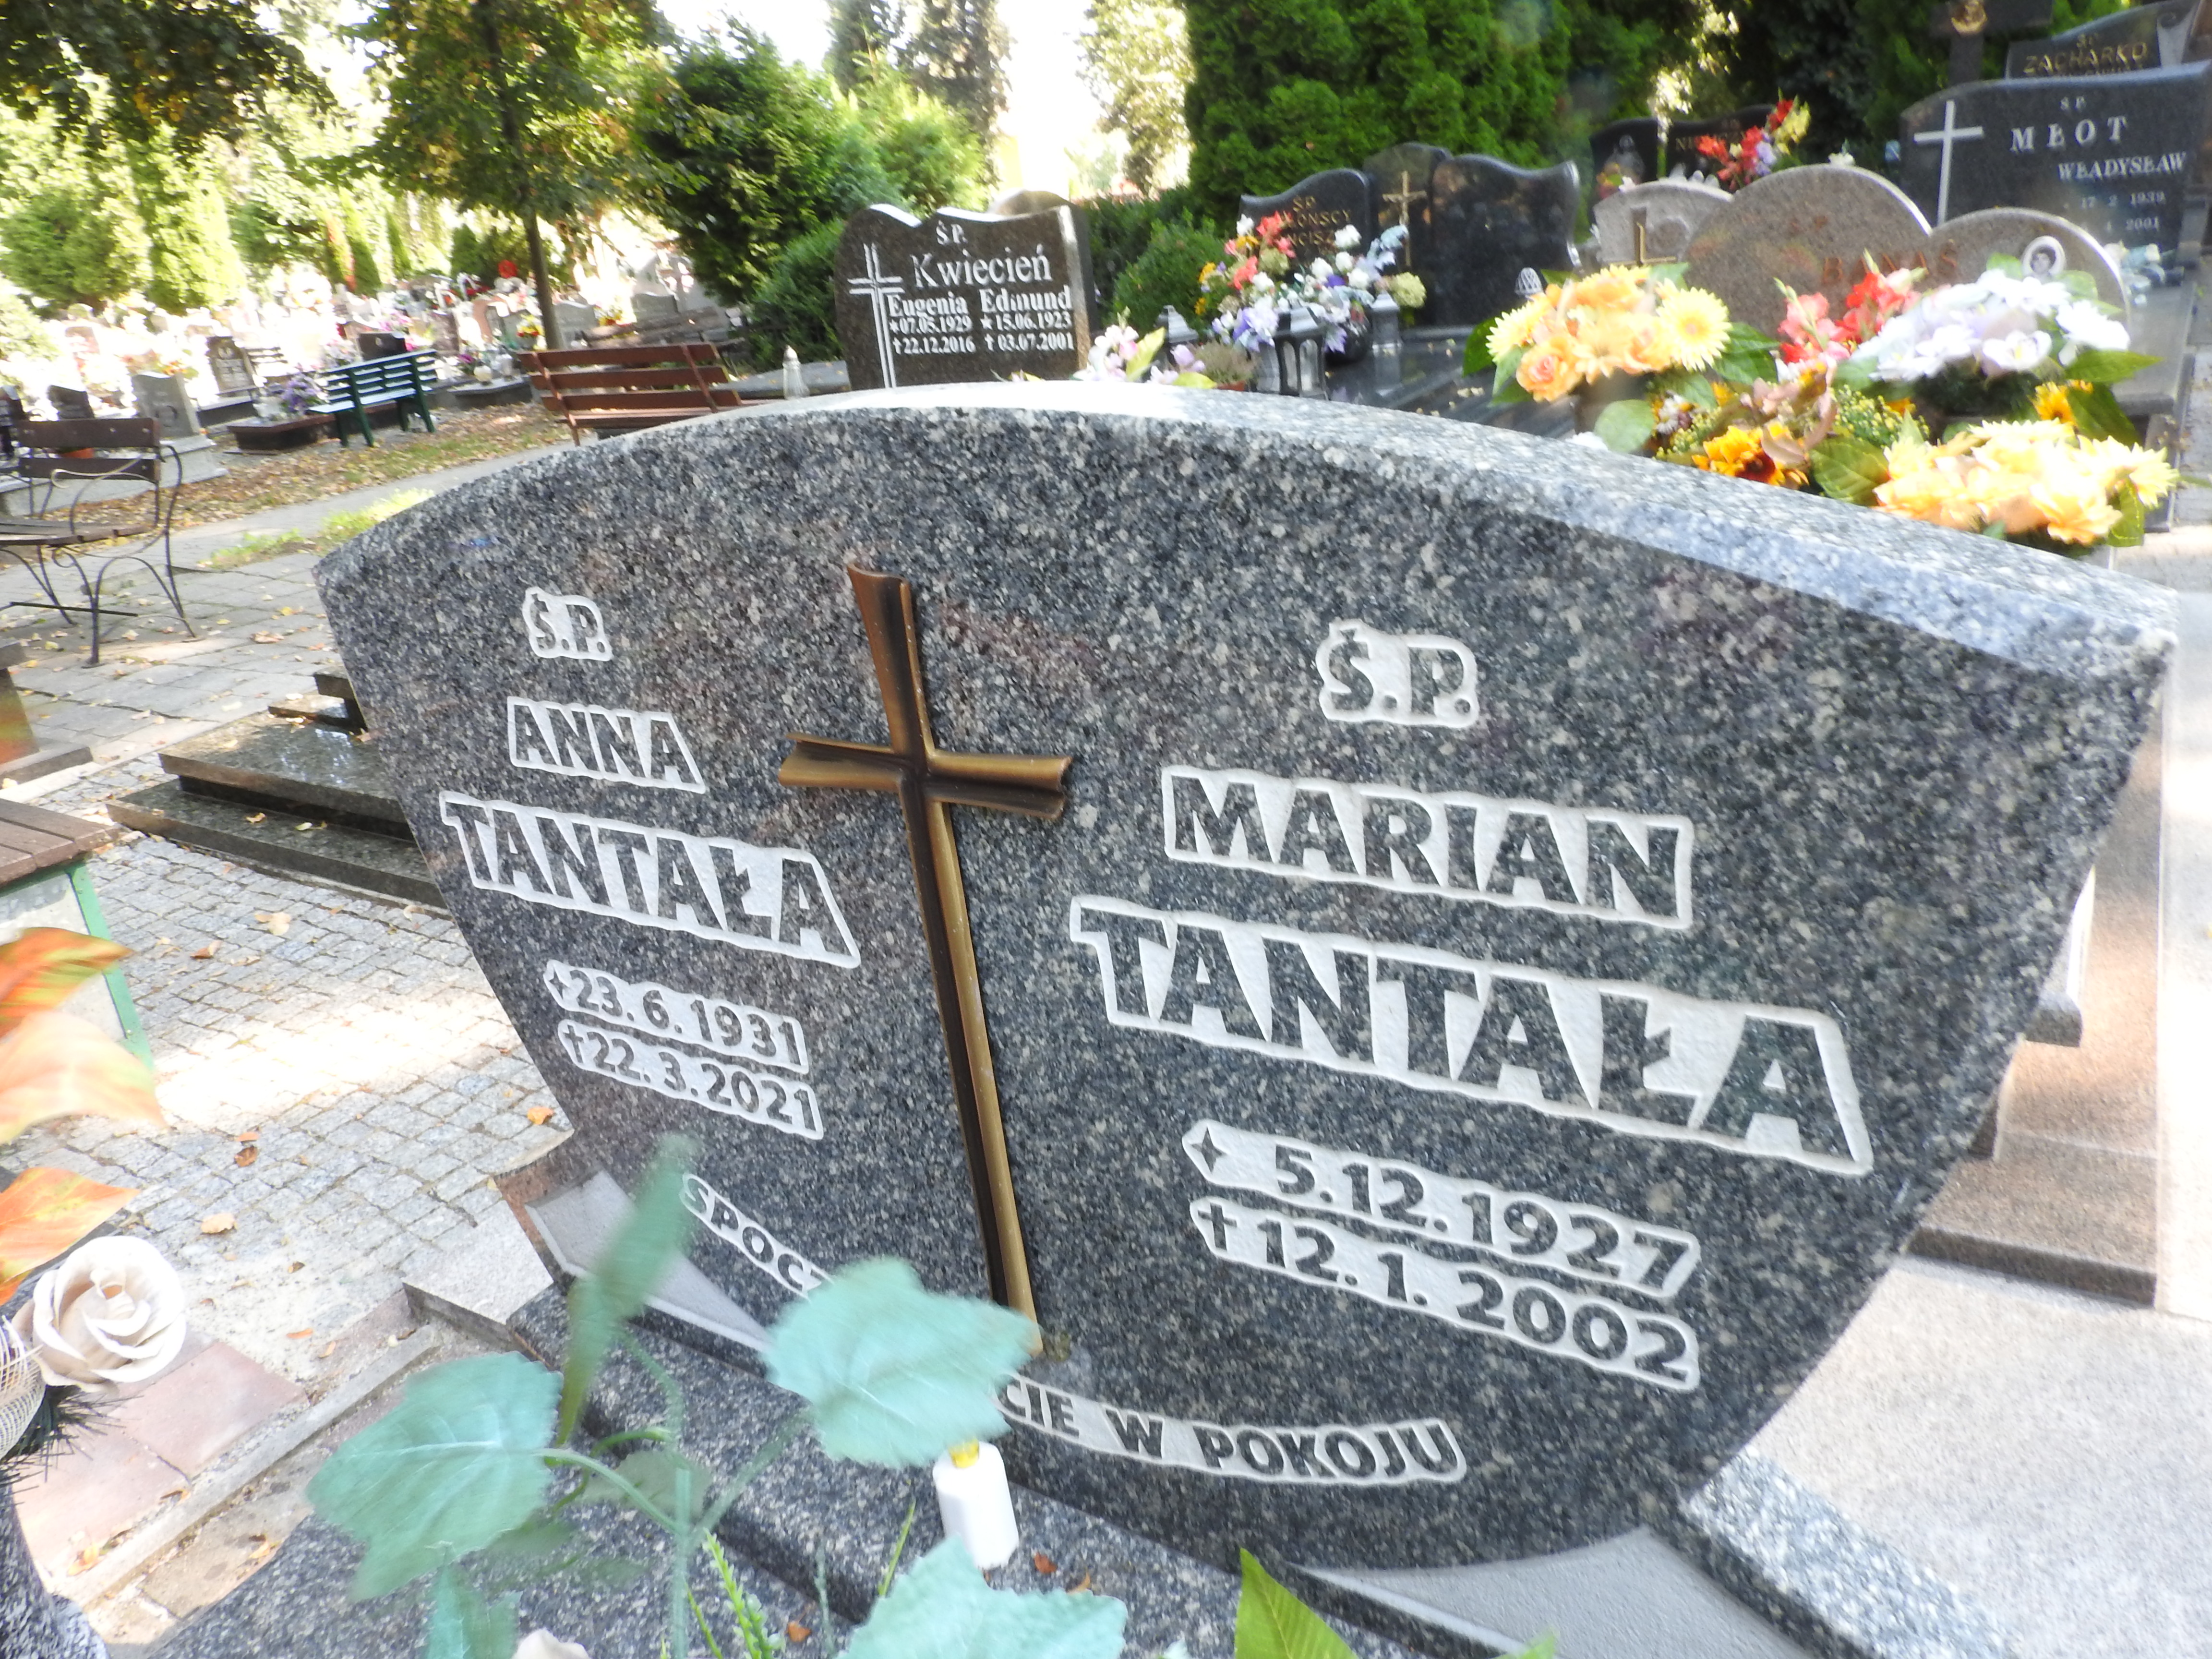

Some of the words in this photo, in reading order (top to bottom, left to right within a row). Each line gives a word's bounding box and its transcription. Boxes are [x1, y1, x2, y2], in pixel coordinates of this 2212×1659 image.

[887, 290, 970, 318] Eugenia
[979, 285, 1073, 313] Edmund
[911, 243, 1052, 287] Kwiecień
[528, 592, 607, 655] Ś.P.
[1326, 625, 1473, 717] Ś.P.
[512, 702, 702, 786] ANNA
[443, 799, 858, 957] TANTAŁA
[1170, 773, 1682, 921] MARIAN
[1079, 905, 1853, 1161] TANTAŁA
[1105, 1407, 1165, 1460] W
[1196, 1420, 1460, 1479] POKOJU
